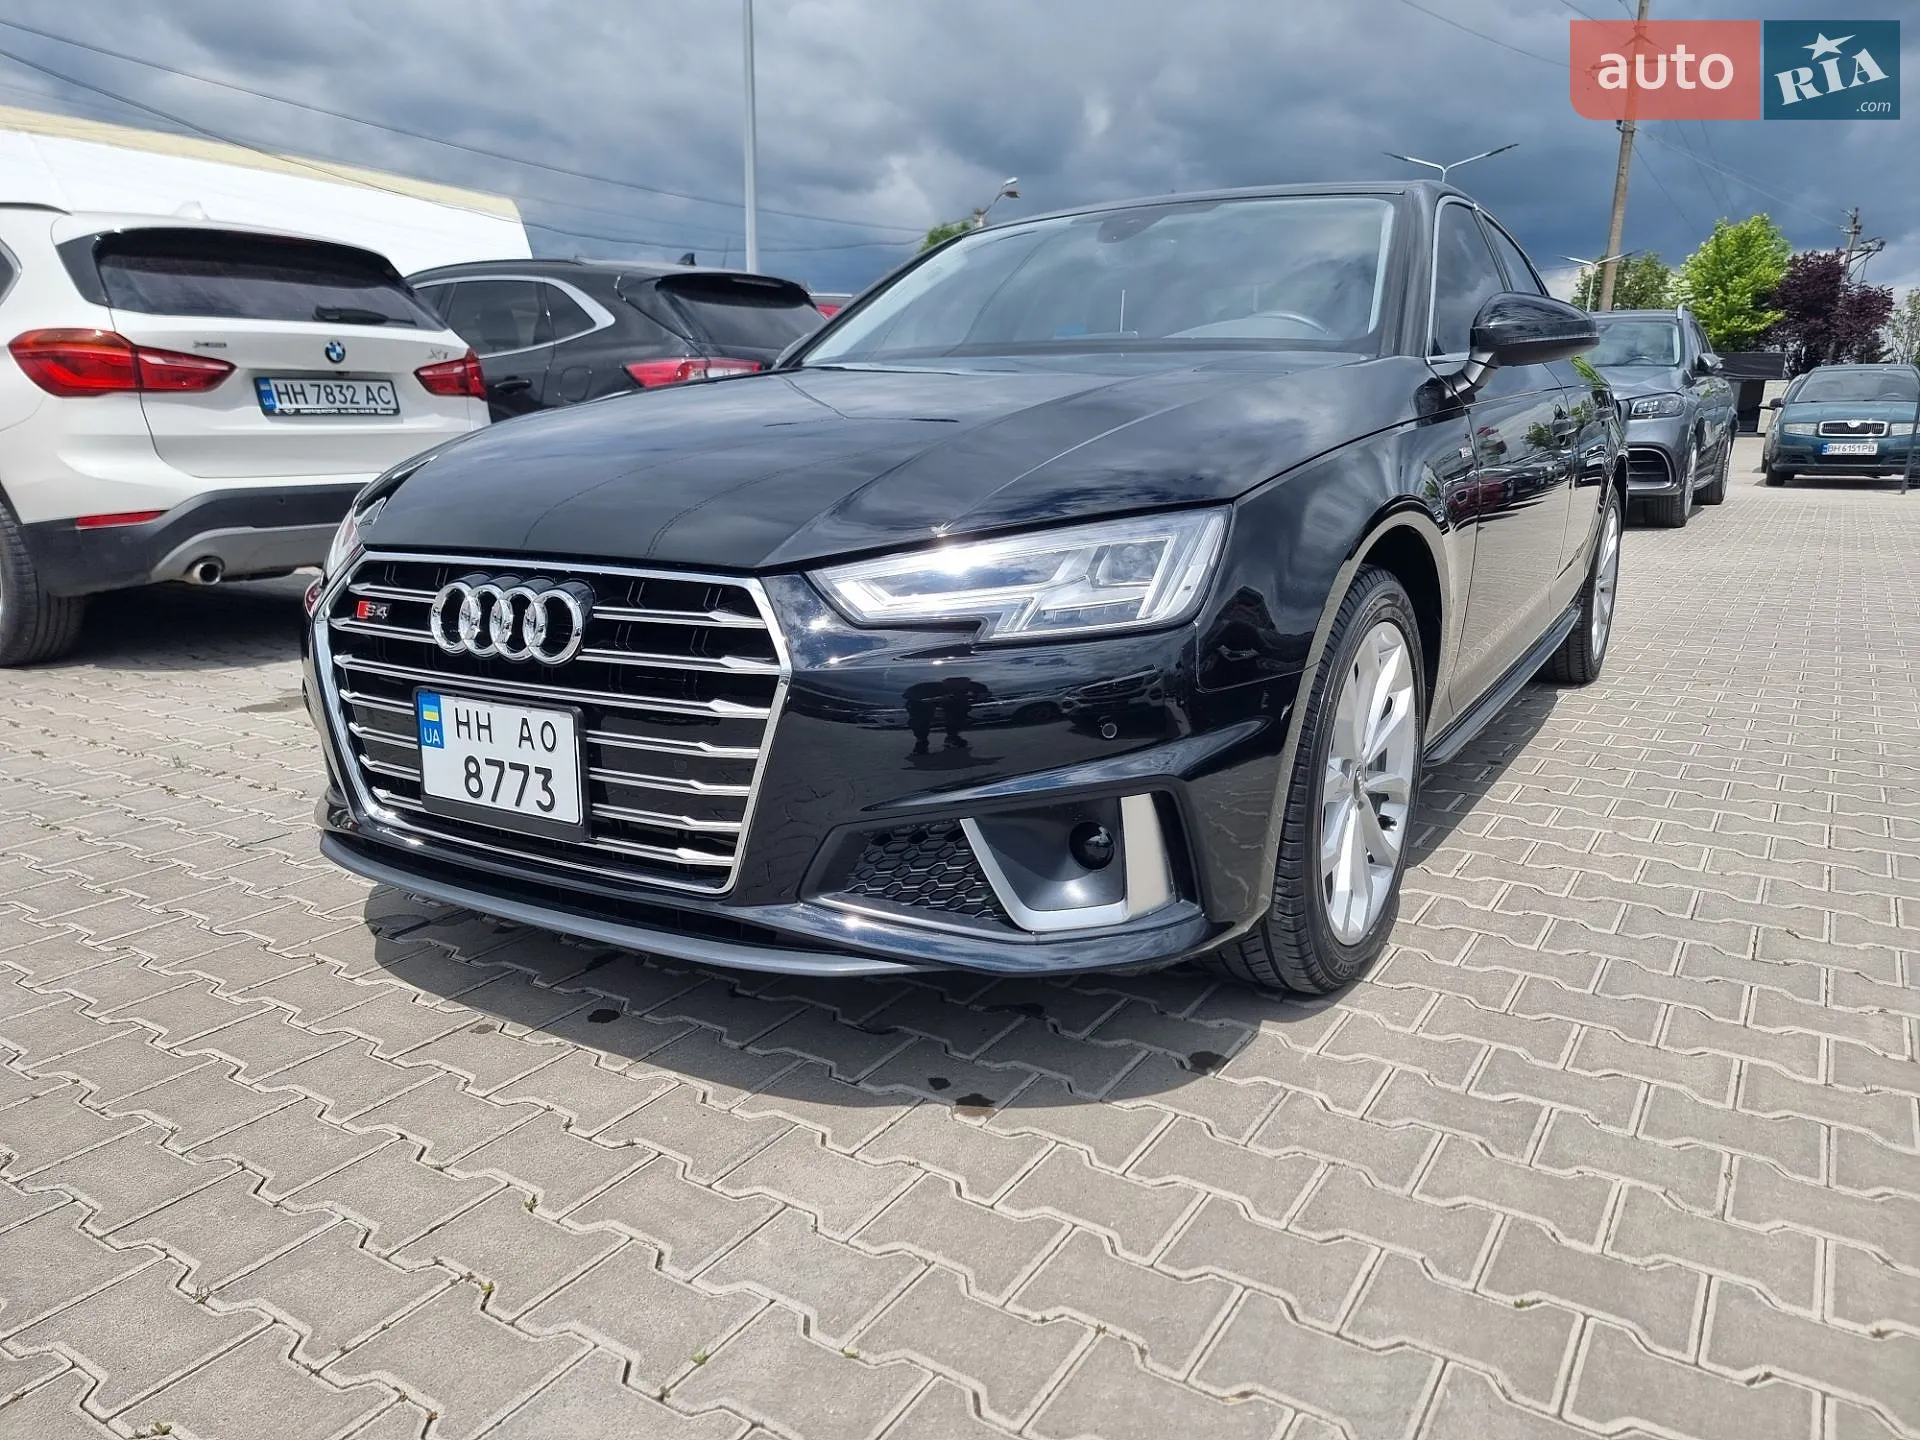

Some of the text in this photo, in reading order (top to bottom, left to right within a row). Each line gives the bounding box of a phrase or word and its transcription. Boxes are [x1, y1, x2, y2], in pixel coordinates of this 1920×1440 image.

[274, 383, 309, 405] HH
[309, 384, 360, 405] 7832
[365, 384, 392, 405] AC
[424, 727, 441, 745] UA
[454, 707, 557, 753] HH AO
[464, 755, 556, 813] 8773
